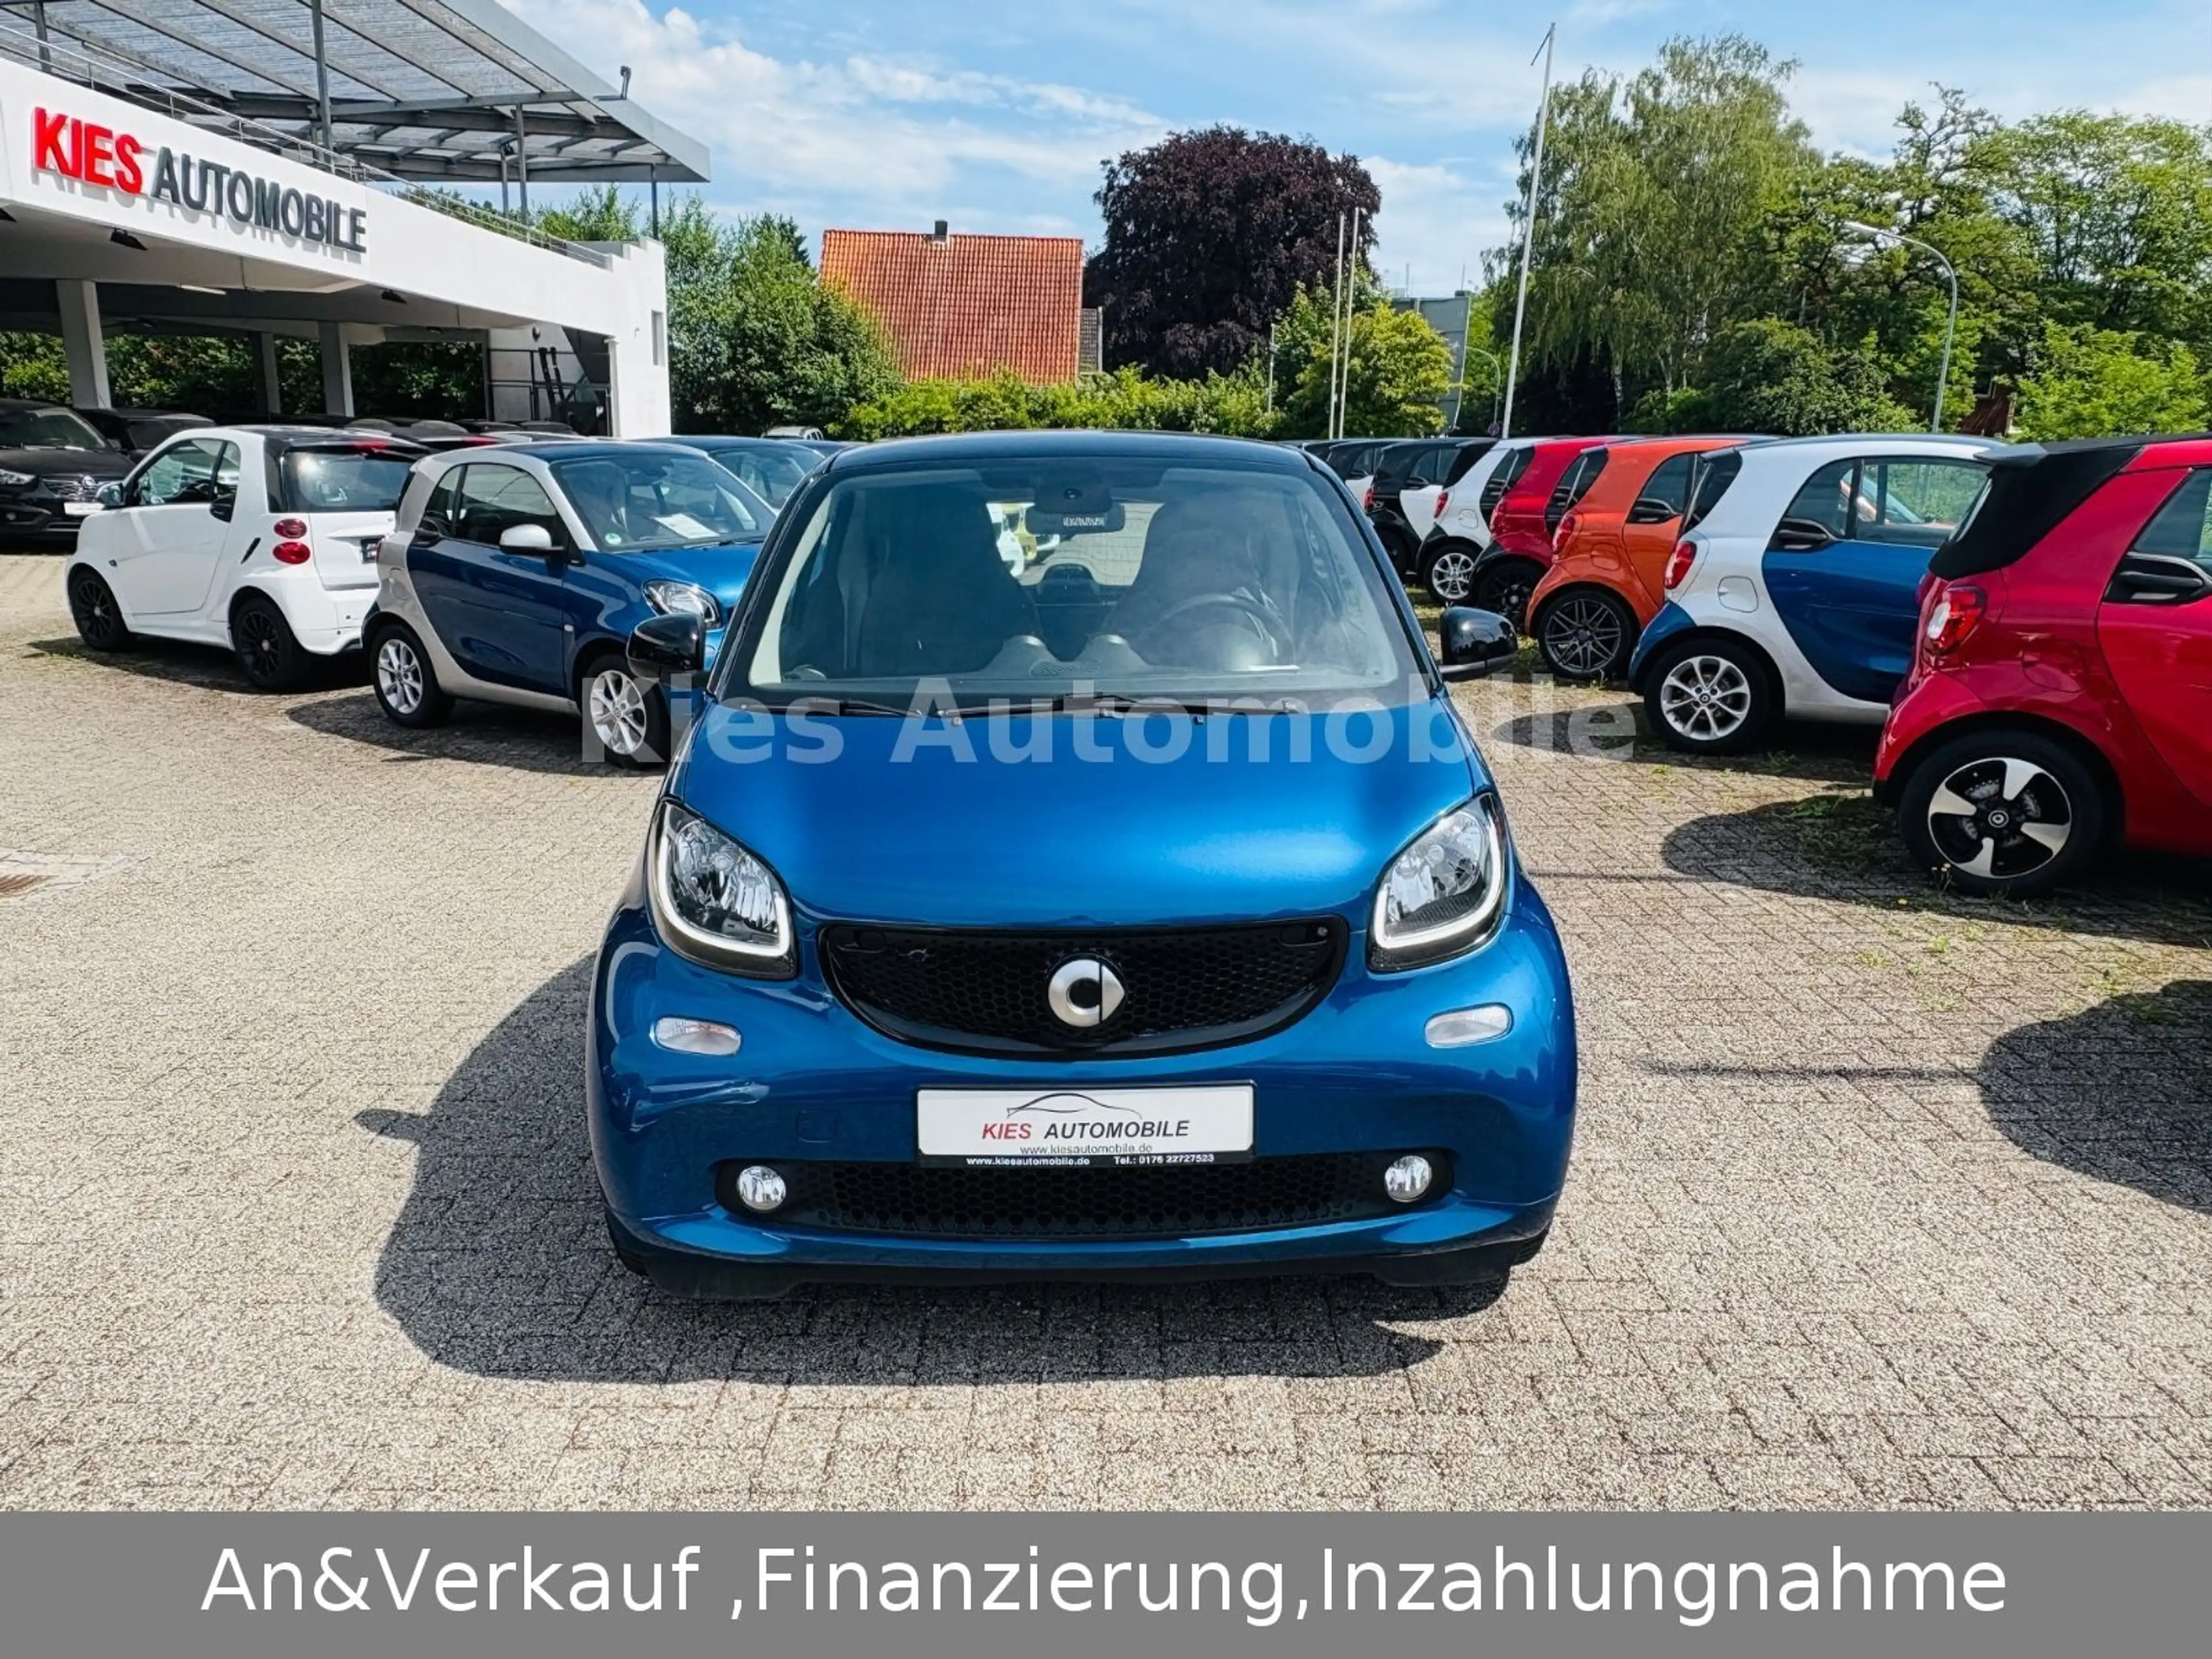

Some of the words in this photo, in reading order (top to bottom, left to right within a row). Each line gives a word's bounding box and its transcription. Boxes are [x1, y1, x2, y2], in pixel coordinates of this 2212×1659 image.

[32, 107, 143, 194] KIES
[151, 146, 367, 254] AUTOMOBILE
[982, 1123, 1032, 1139] KIES
[1043, 1120, 1190, 1139] AUTOMOBILE
[1020, 1143, 1153, 1154] www.kiesautomobile.de
[965, 1157, 1090, 1165] www.kiesautomobile.de
[1113, 1156, 1137, 1165] Tel.:
